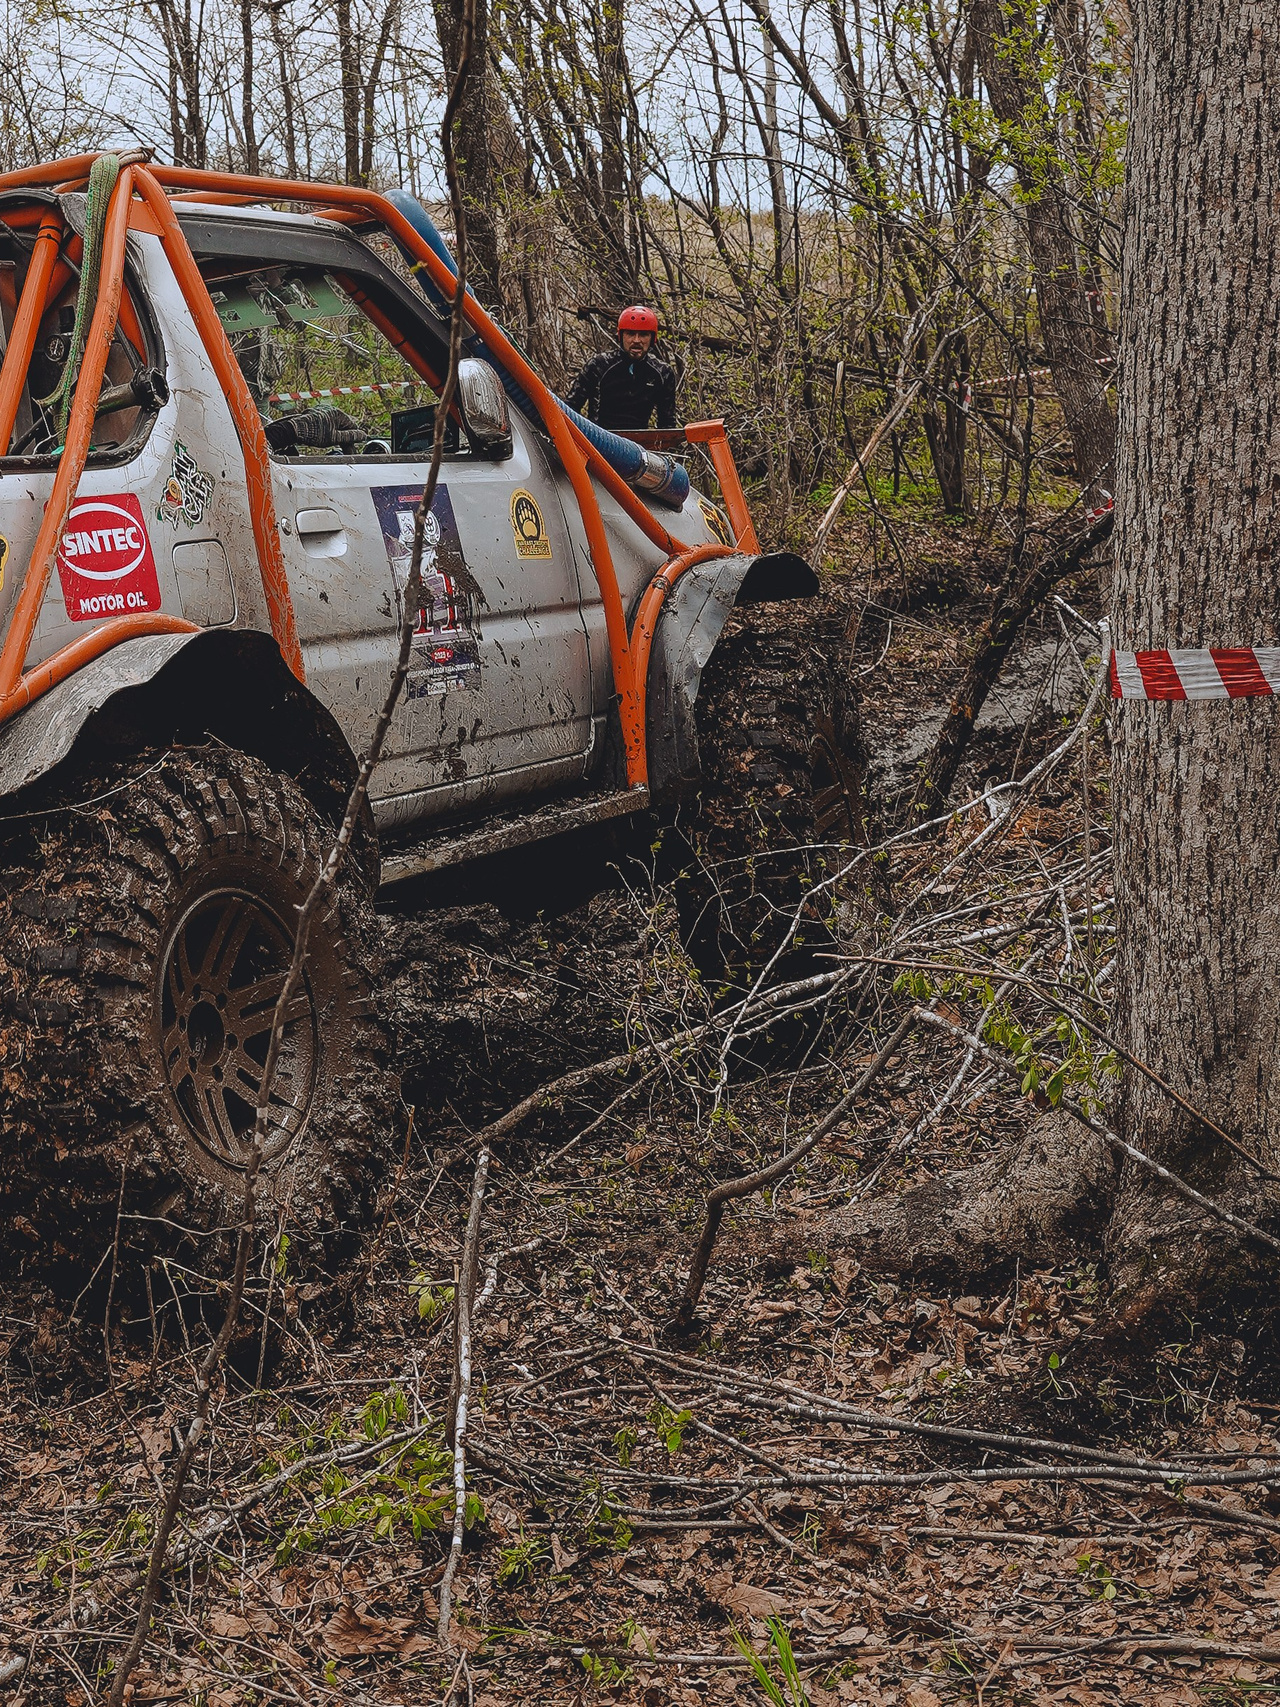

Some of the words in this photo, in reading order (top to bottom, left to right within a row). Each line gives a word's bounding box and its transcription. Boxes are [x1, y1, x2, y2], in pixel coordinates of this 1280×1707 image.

[62, 527, 141, 556] SINTEC
[518, 545, 550, 555] CHALLENGE
[80, 594, 125, 614] MOTOR
[127, 591, 149, 607] OIL
